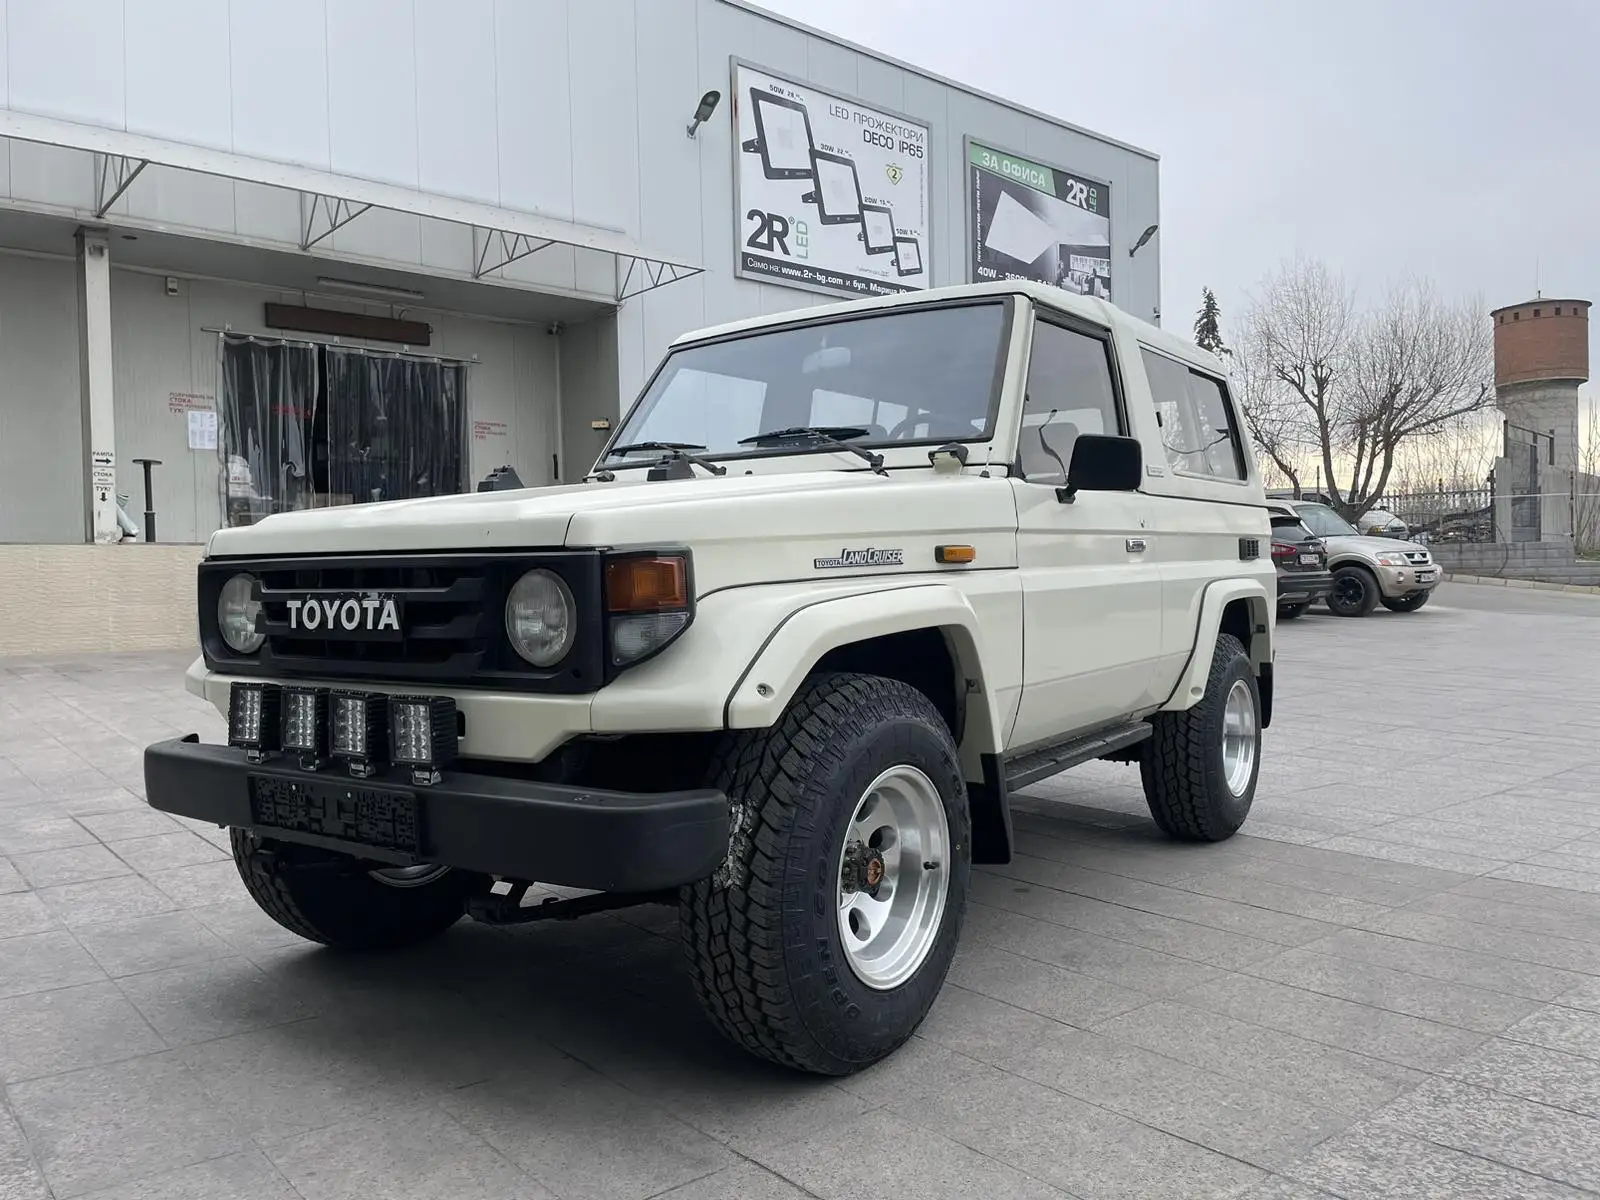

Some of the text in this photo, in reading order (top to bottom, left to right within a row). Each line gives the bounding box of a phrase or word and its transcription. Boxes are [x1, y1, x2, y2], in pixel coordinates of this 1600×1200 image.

[769, 84, 785, 96] 50W
[829, 103, 924, 143] LED ПРОЖЕКТОРИ
[863, 129, 924, 159] DECO IP65
[982, 151, 1046, 187] ЗА ОФИСА
[1065, 178, 1088, 210] 2R
[1089, 187, 1097, 213] LED
[796, 220, 808, 259] LED
[747, 257, 769, 271] Само
[769, 264, 781, 273] на:
[781, 267, 843, 285] www.2r-bg.com
[852, 279, 868, 291] бул.
[977, 267, 997, 279] 40W
[816, 559, 841, 567] TOYOTA
[286, 599, 400, 631] TOYOTA
